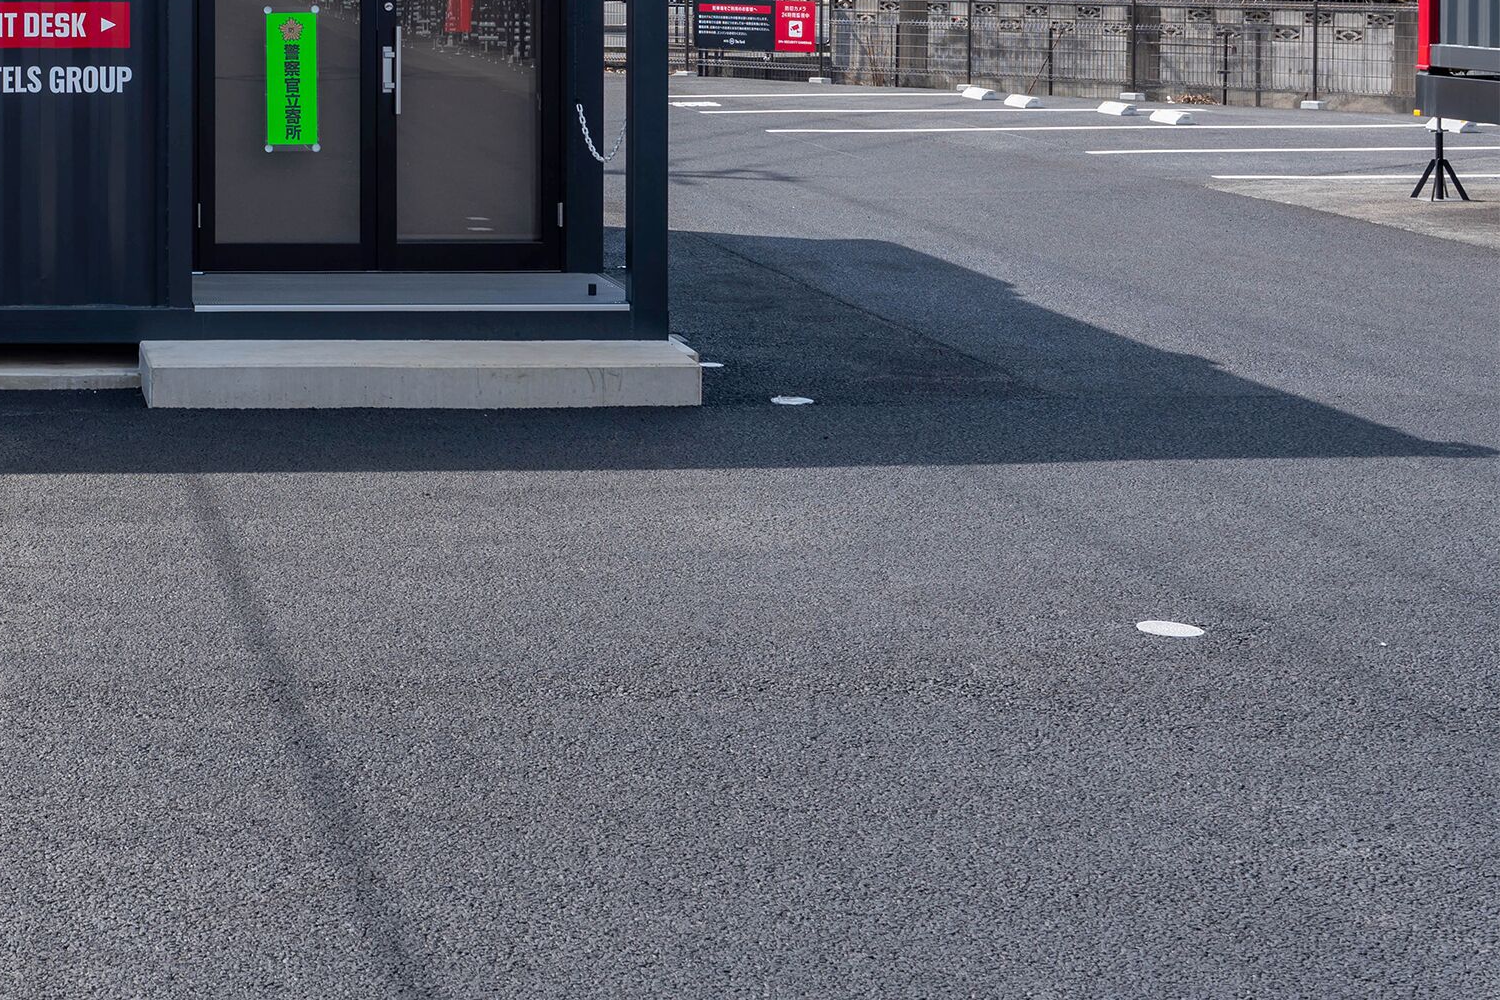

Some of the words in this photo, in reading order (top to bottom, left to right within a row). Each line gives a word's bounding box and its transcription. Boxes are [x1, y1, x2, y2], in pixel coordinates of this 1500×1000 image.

[24, 12, 87, 38] DESK
[49, 66, 133, 94] GROUP
[283, 43, 302, 141] 警察官立寄所
